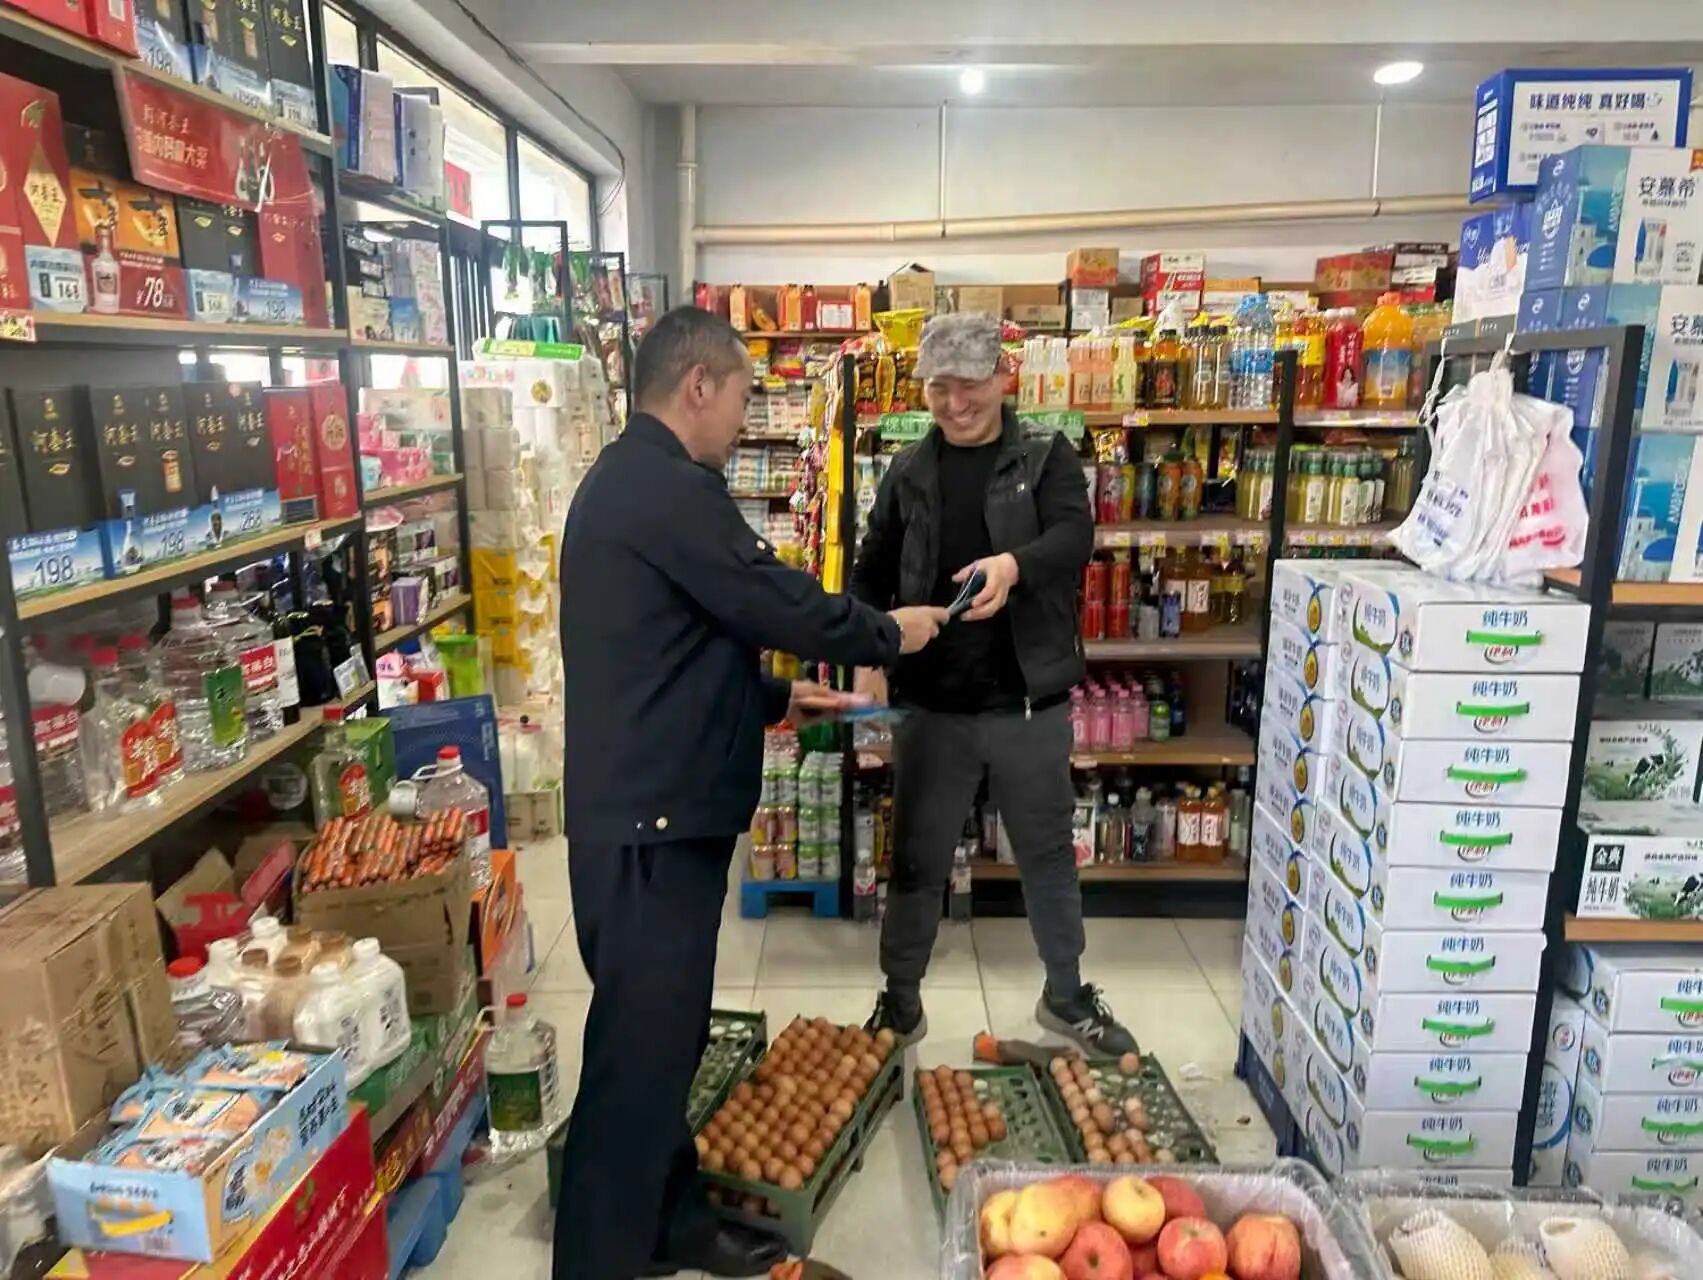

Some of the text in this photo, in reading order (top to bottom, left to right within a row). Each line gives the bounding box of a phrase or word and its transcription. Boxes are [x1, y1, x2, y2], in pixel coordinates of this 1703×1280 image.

[1530, 93, 1646, 110] 味道纯纯 真好喝
[35, 554, 74, 586] 198
[1482, 610, 1528, 627] 纯牛奶
[1472, 680, 1518, 697] 纯牛奶
[1464, 747, 1511, 763] 纯牛奶
[1455, 810, 1501, 827] 纯牛奶
[1594, 846, 1622, 867] 金典
[1450, 872, 1493, 888] 纯牛奶
[1585, 875, 1620, 904] 纯牛奶
[1441, 936, 1484, 952] 纯牛奶
[1437, 999, 1480, 1015] 纯牛奶
[1429, 1055, 1471, 1072] 纯牛奶
[1657, 1098, 1698, 1113] 纯牛奶
[1421, 1116, 1463, 1132] 纯牛奶
[1646, 1158, 1688, 1173] 纯牛奶
